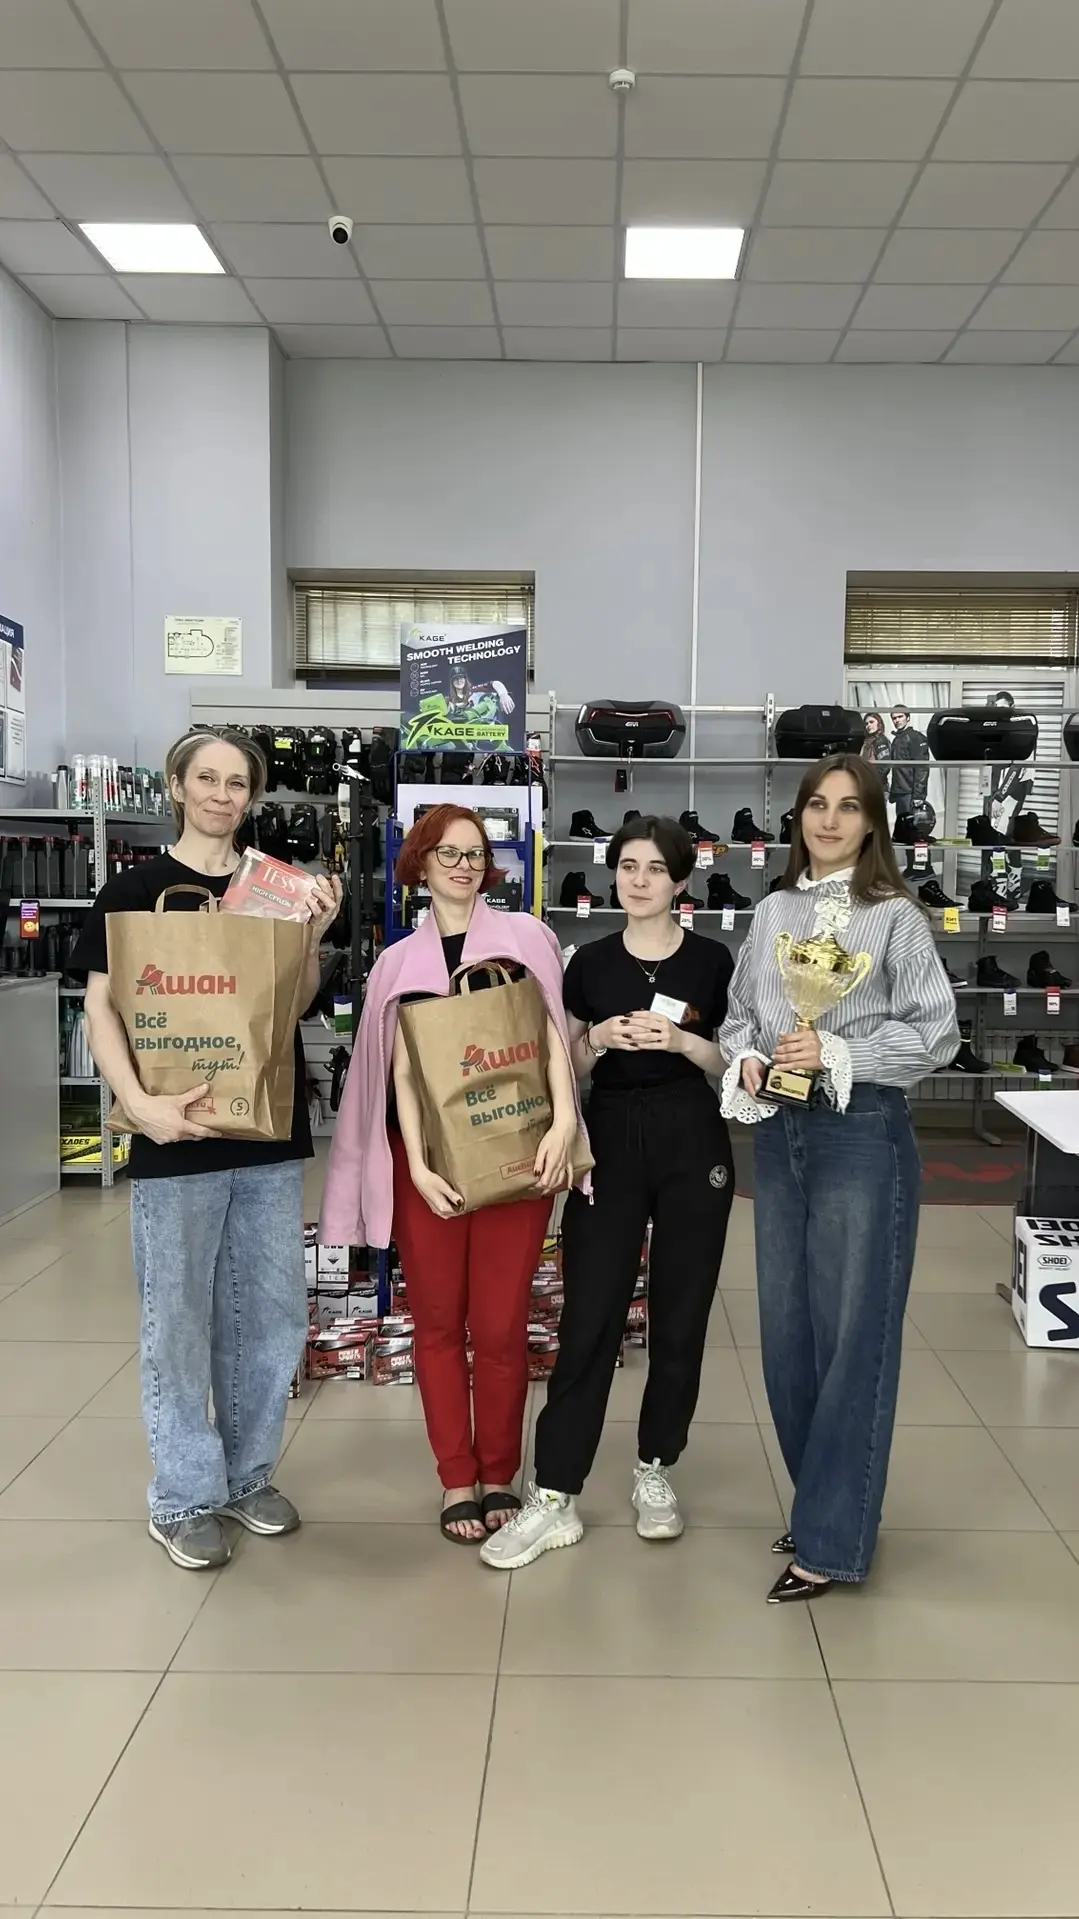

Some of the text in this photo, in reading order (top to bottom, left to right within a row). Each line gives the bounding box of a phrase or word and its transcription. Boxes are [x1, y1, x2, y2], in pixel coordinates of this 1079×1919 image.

[406, 638, 504, 662] SMOOTH WELDING
[447, 645, 521, 665] TECHNOLOGY
[434, 727, 474, 737] KAGE
[262, 866, 296, 894] TESS
[251, 885, 268, 898] HIGH
[136, 964, 237, 995] Ашан
[135, 1012, 167, 1029] Всё
[134, 1036, 241, 1052] выгодное,
[191, 1051, 245, 1081] тут!
[464, 1084, 497, 1107] Всё
[236, 1102, 243, 1111] 5
[470, 1094, 549, 1127] выгодно
[1042, 1256, 1067, 1265] SHOEI
